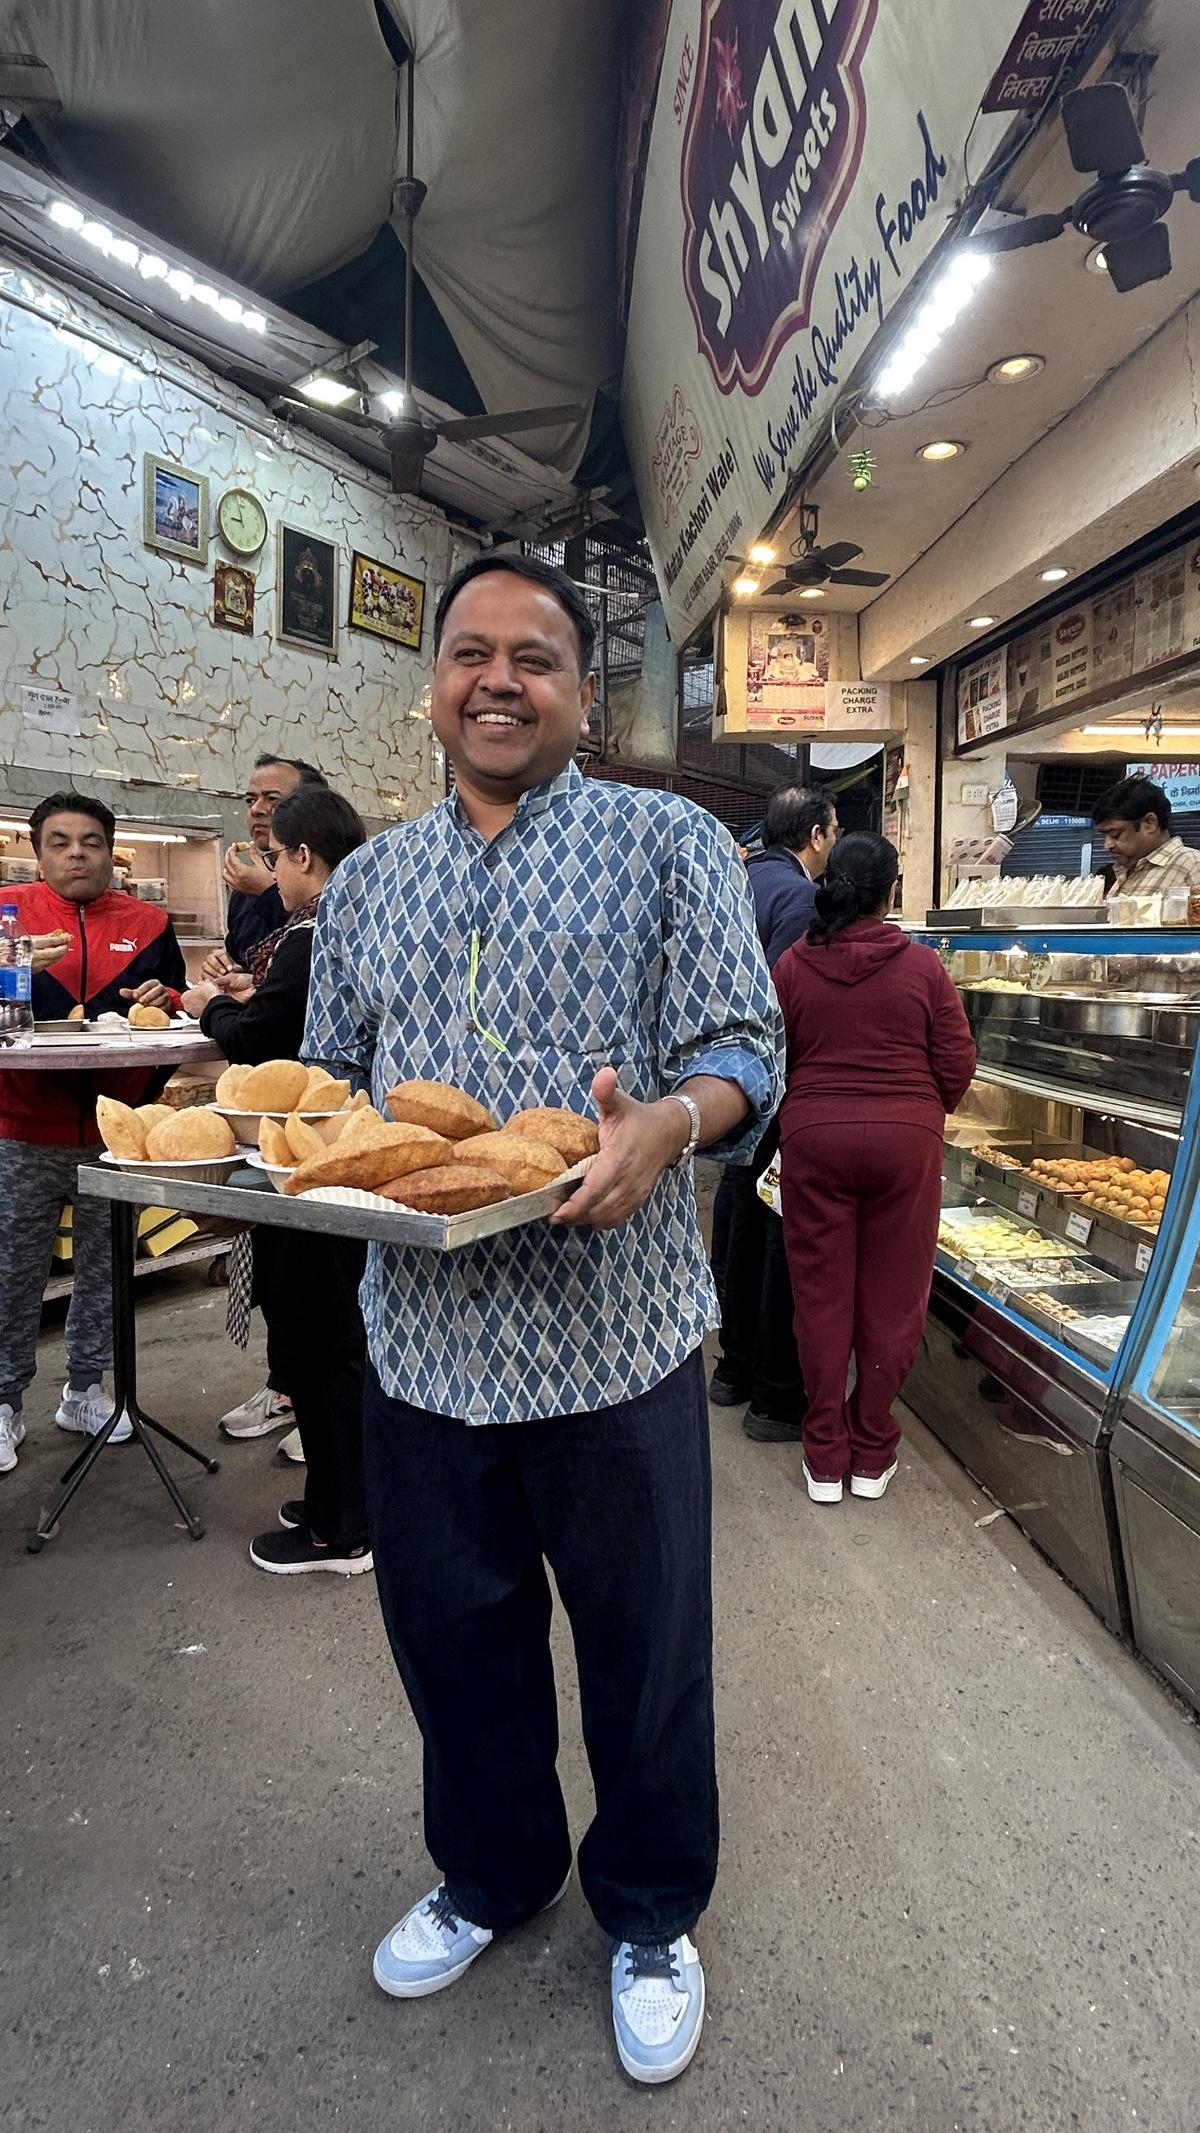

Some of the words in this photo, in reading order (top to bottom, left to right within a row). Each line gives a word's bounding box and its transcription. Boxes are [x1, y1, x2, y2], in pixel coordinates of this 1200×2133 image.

[673, 33, 696, 125] SINCE
[791, 354, 818, 421] the
[811, 256, 884, 388] Quality
[876, 110, 947, 277] Food
[680, 487, 713, 557] Kachori
[841, 687, 878, 695] PACKING
[846, 706, 873, 714] EXTRA
[982, 699, 1002, 712] PACKING
[983, 709, 1001, 723] CHARGE
[985, 721, 1000, 732] EXTRA
